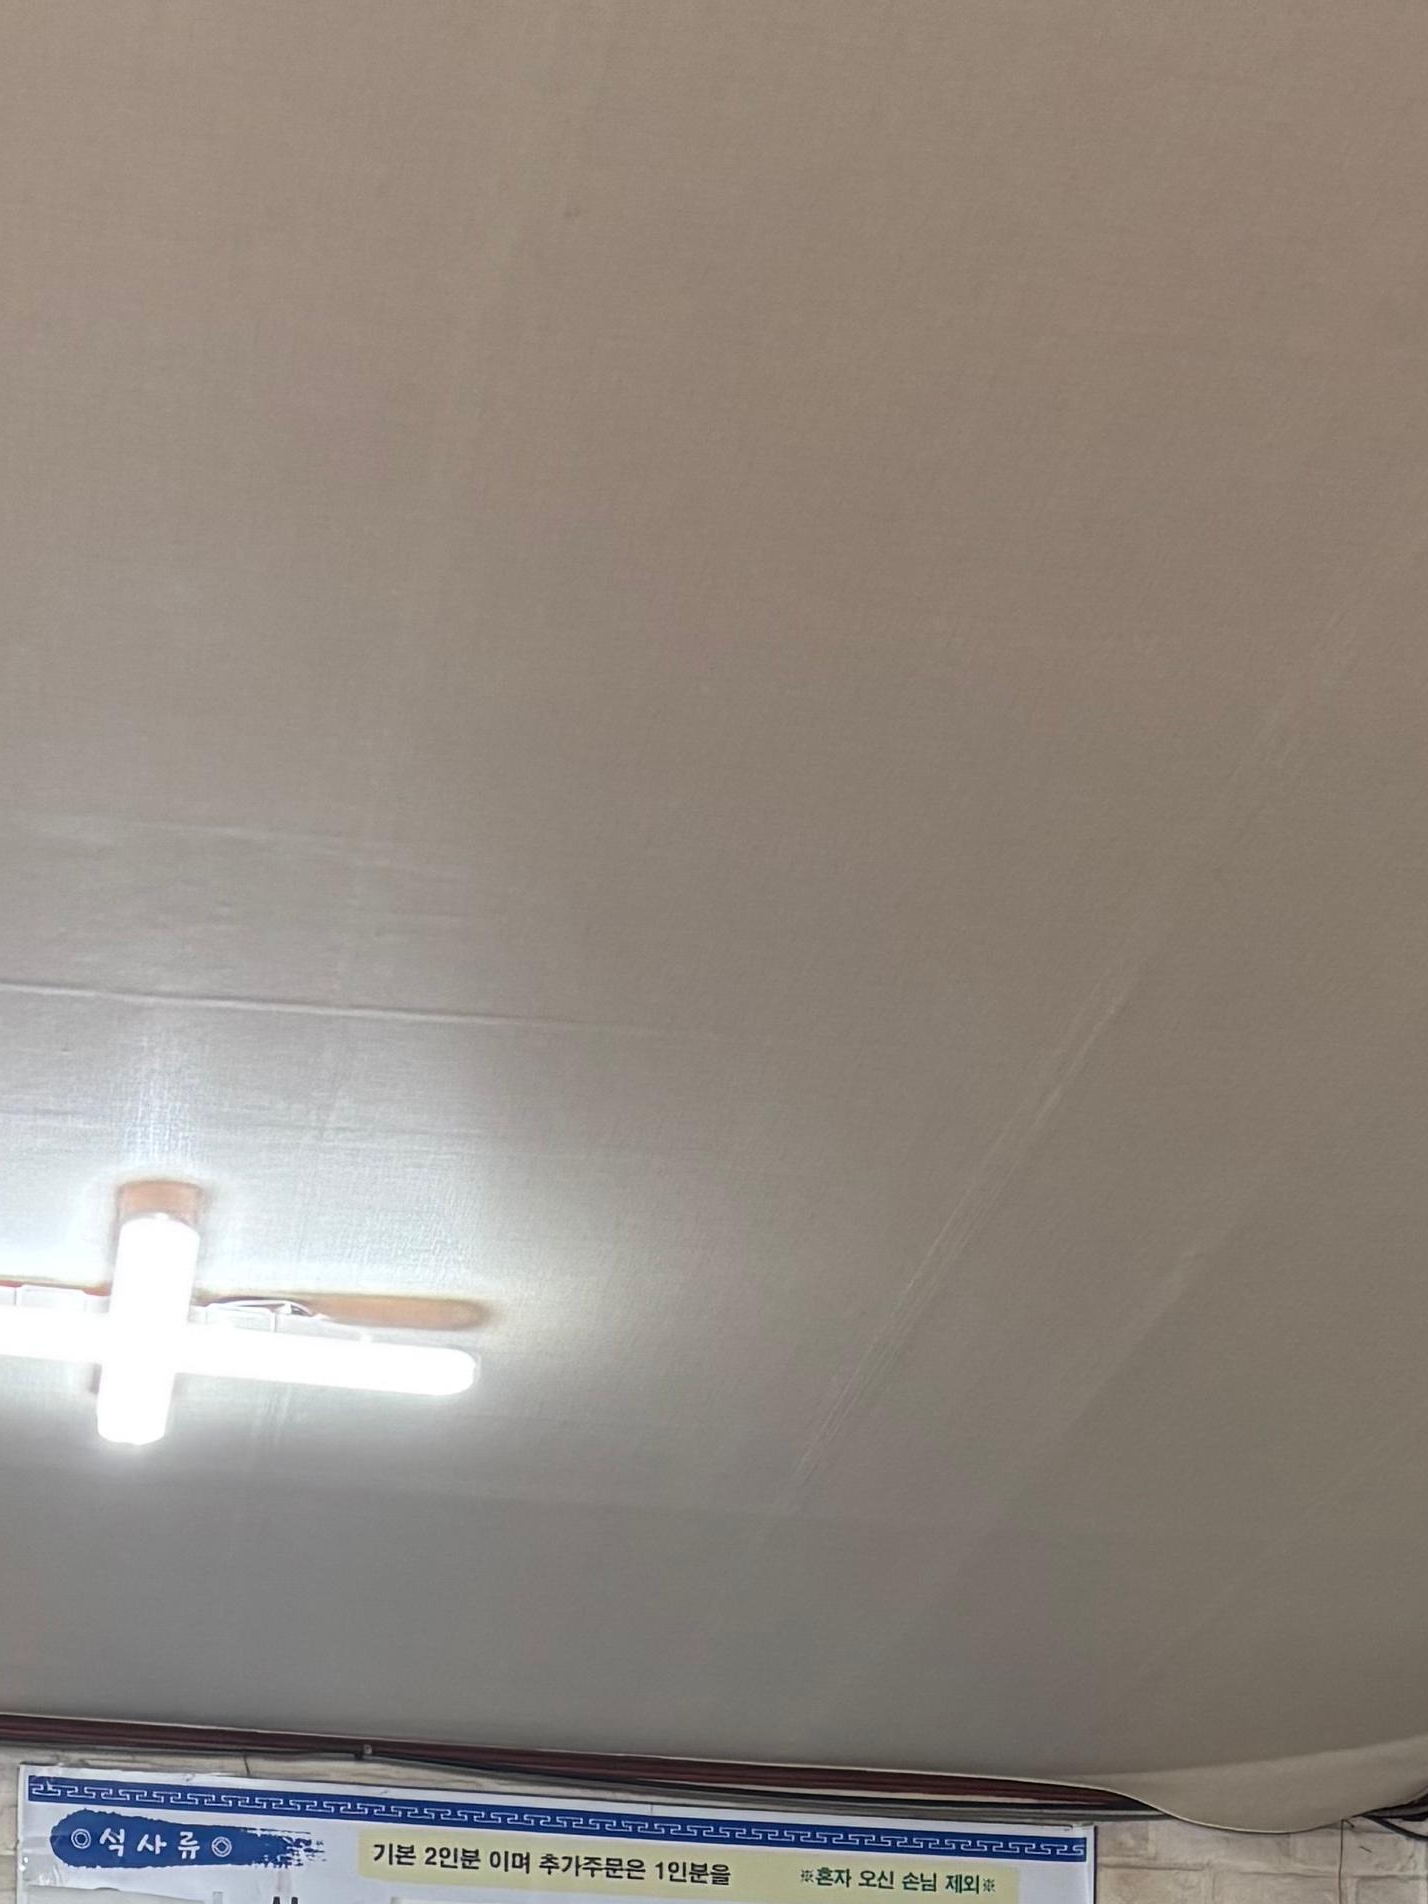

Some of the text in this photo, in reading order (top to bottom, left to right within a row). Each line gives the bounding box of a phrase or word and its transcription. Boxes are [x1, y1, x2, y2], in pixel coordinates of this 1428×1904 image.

[373, 1843, 731, 1886] 기본 2인분 이며 추가주문은 1인분을
[858, 1868, 894, 1891] 오신
[901, 1870, 938, 1894] 손님
